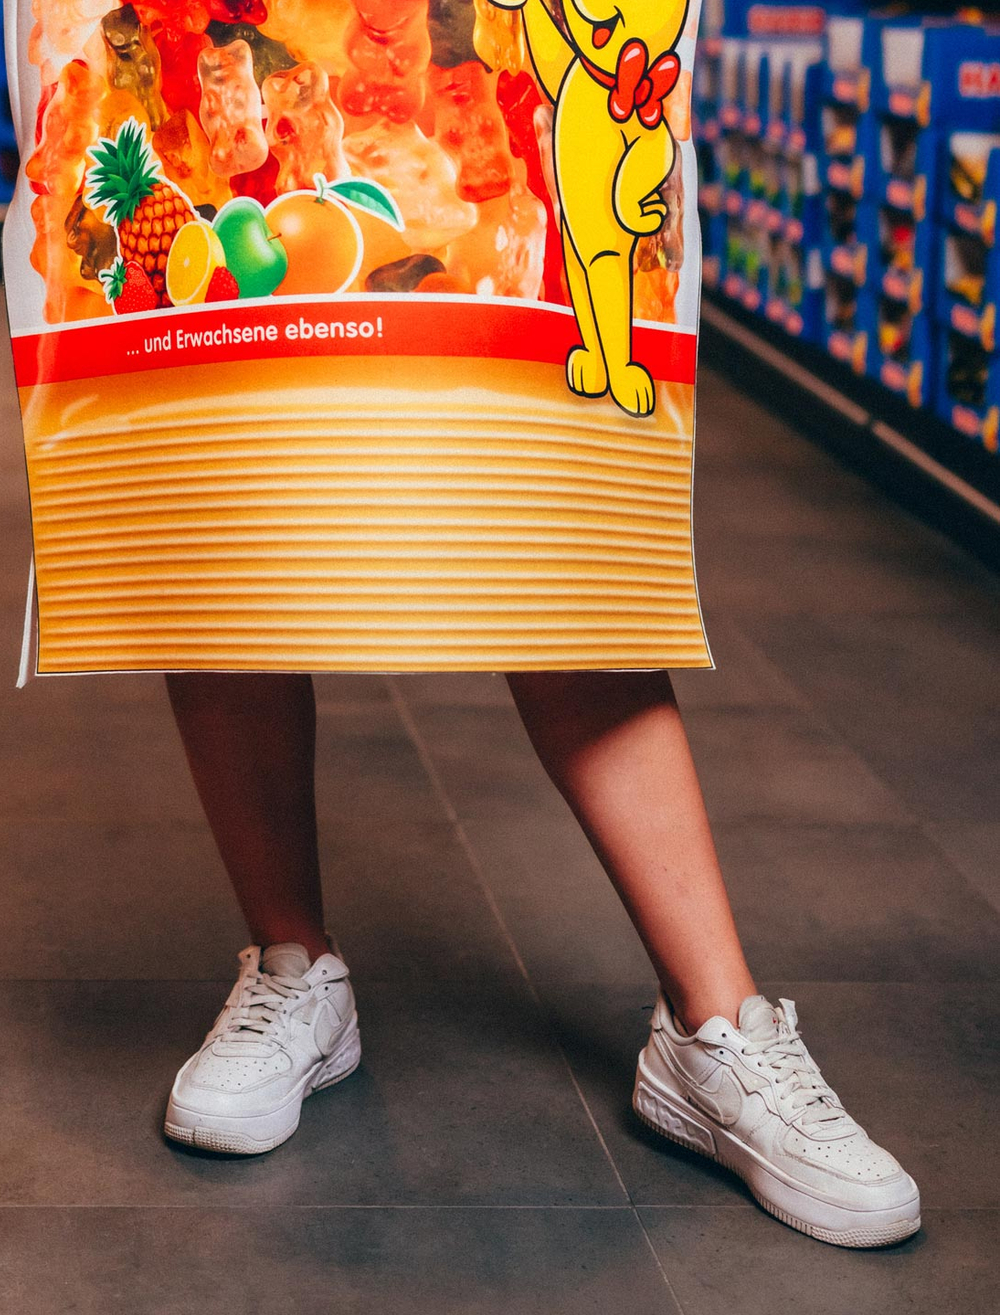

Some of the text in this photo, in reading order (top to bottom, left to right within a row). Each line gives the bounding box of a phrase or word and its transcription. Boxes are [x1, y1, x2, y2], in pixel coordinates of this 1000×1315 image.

[144, 329, 172, 353] und
[176, 323, 278, 350] Erwachsene
[285, 317, 383, 340] ebenso!
